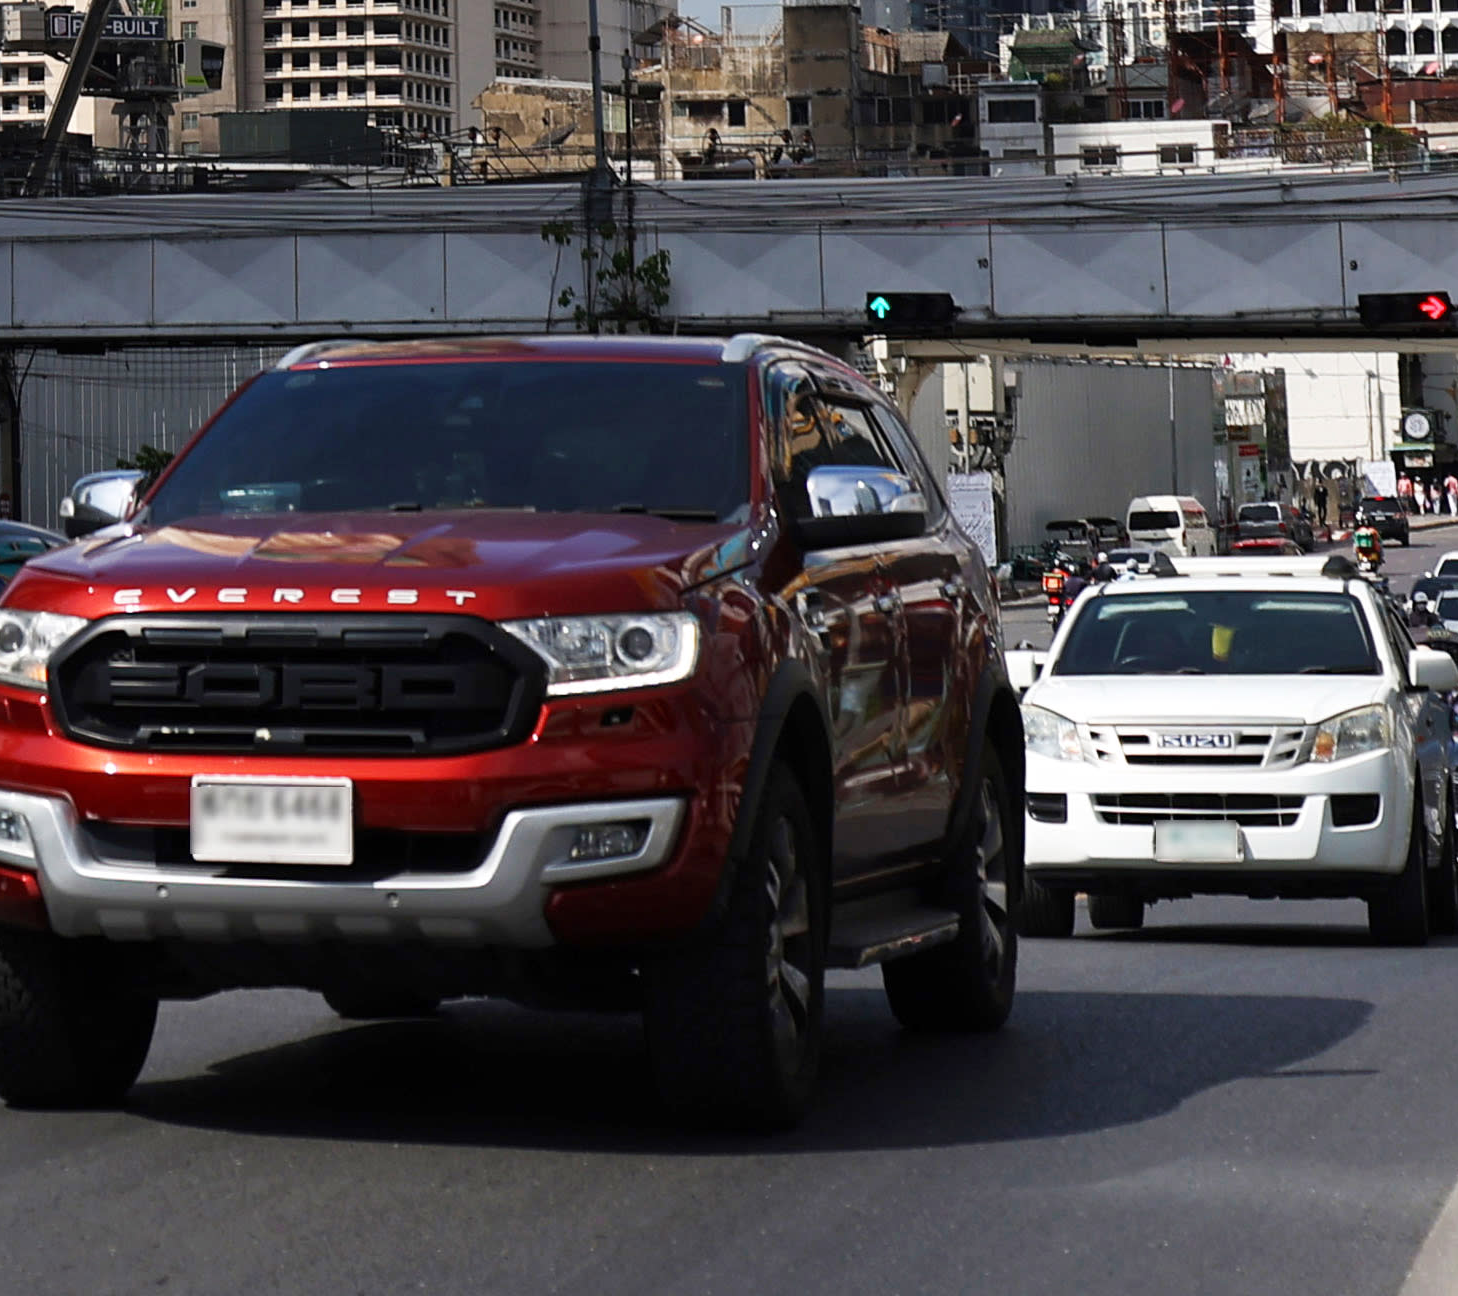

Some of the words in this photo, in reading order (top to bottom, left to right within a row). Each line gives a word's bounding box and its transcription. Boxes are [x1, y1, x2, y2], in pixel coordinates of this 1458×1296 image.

[72, 20, 159, 36] P-BUILT
[113, 587, 477, 606] EVEREST
[1156, 734, 1232, 749] ISUZU
